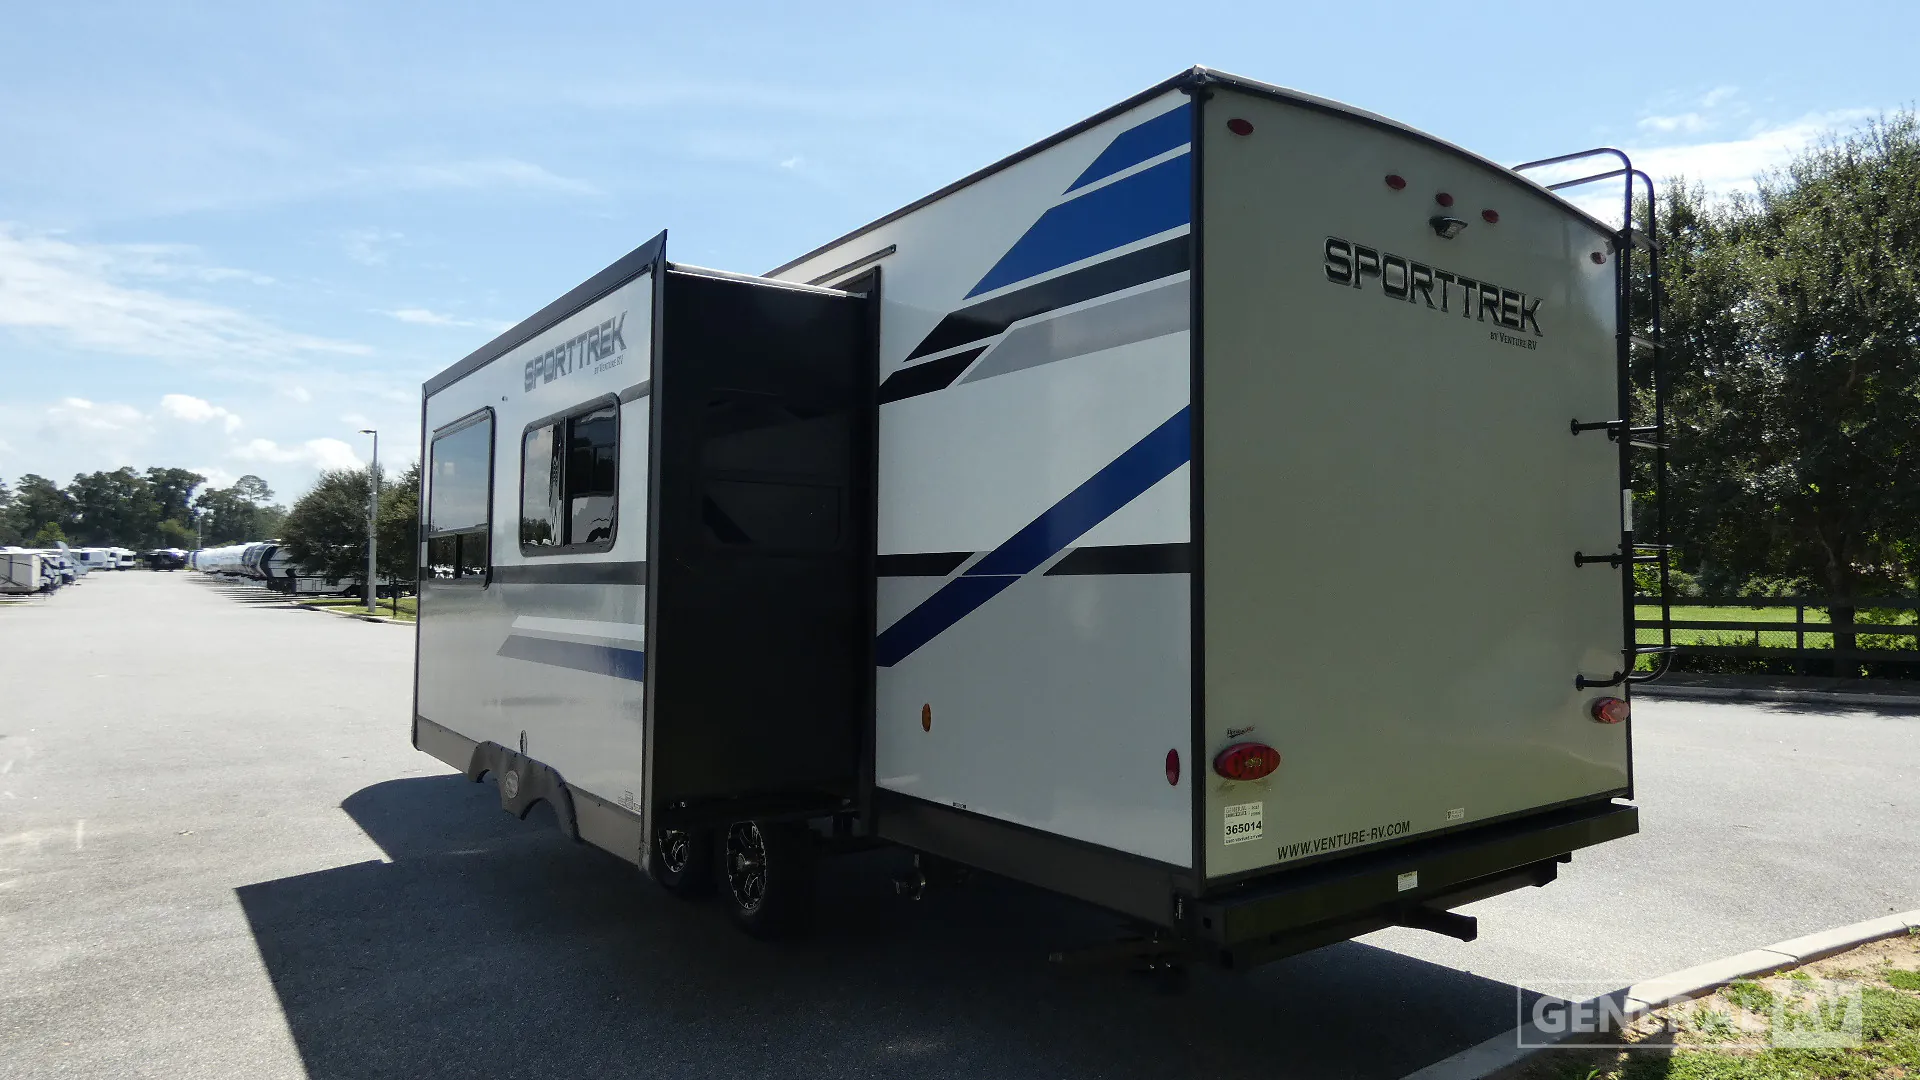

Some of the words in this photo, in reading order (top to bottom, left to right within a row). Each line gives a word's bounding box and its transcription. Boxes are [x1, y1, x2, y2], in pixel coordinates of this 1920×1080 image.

[1323, 235, 1544, 337] SPORTTREK
[524, 310, 628, 393] SPORTTREK
[1527, 339, 1538, 350] RV
[1225, 820, 1262, 836] 365014
[1277, 820, 1411, 860] WWW.VENTURE-RV.COM
